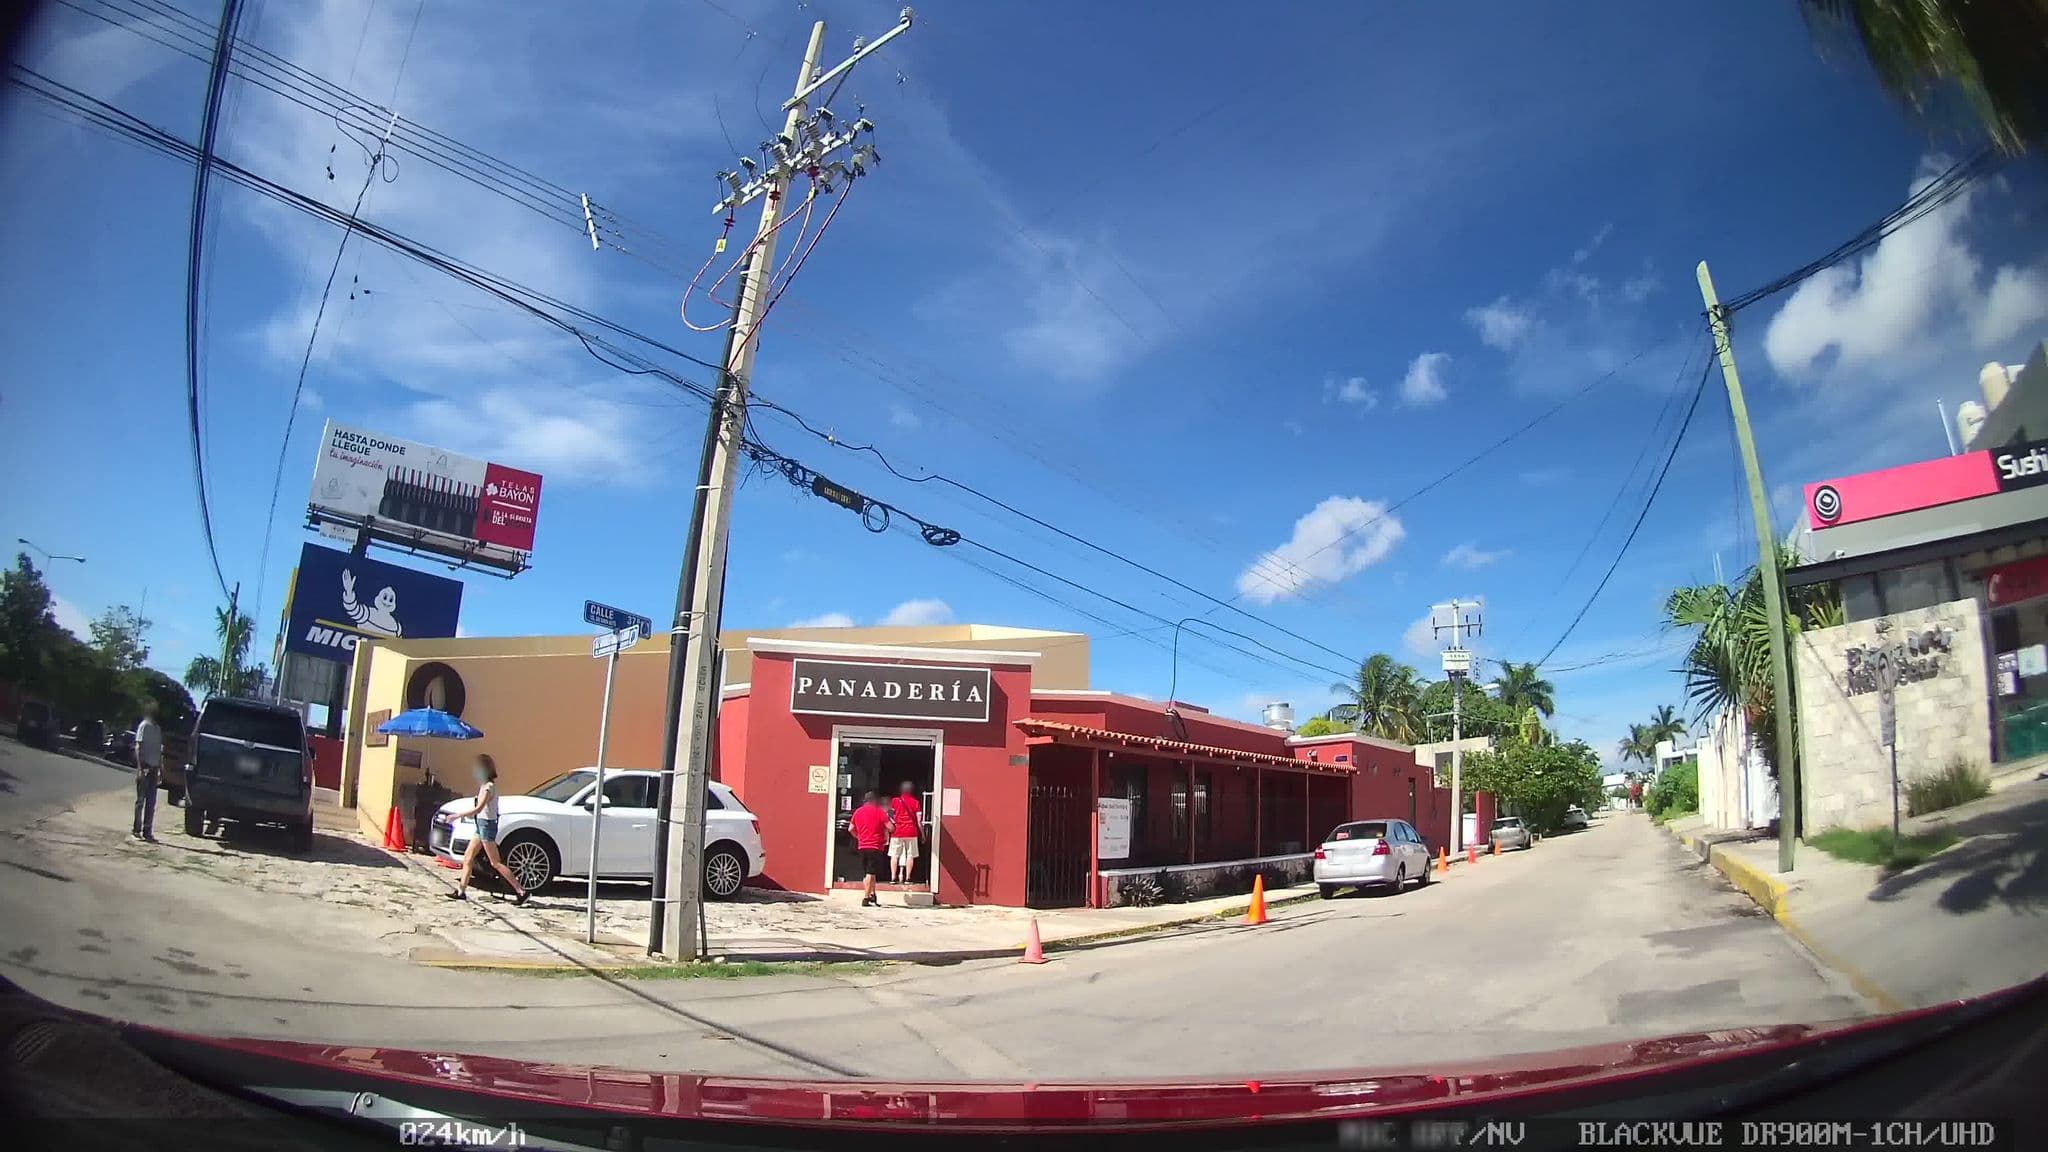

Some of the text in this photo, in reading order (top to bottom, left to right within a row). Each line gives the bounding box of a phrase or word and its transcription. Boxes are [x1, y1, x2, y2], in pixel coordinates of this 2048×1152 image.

[331, 438, 371, 456] LLEGUE
[334, 428, 406, 456] HASTA DONDE
[1997, 447, 2048, 480] Sushi
[501, 480, 535, 494] TELAS
[492, 515, 506, 526] DEL
[590, 604, 615, 620] CALLE
[797, 677, 984, 703] PANADERÍA
